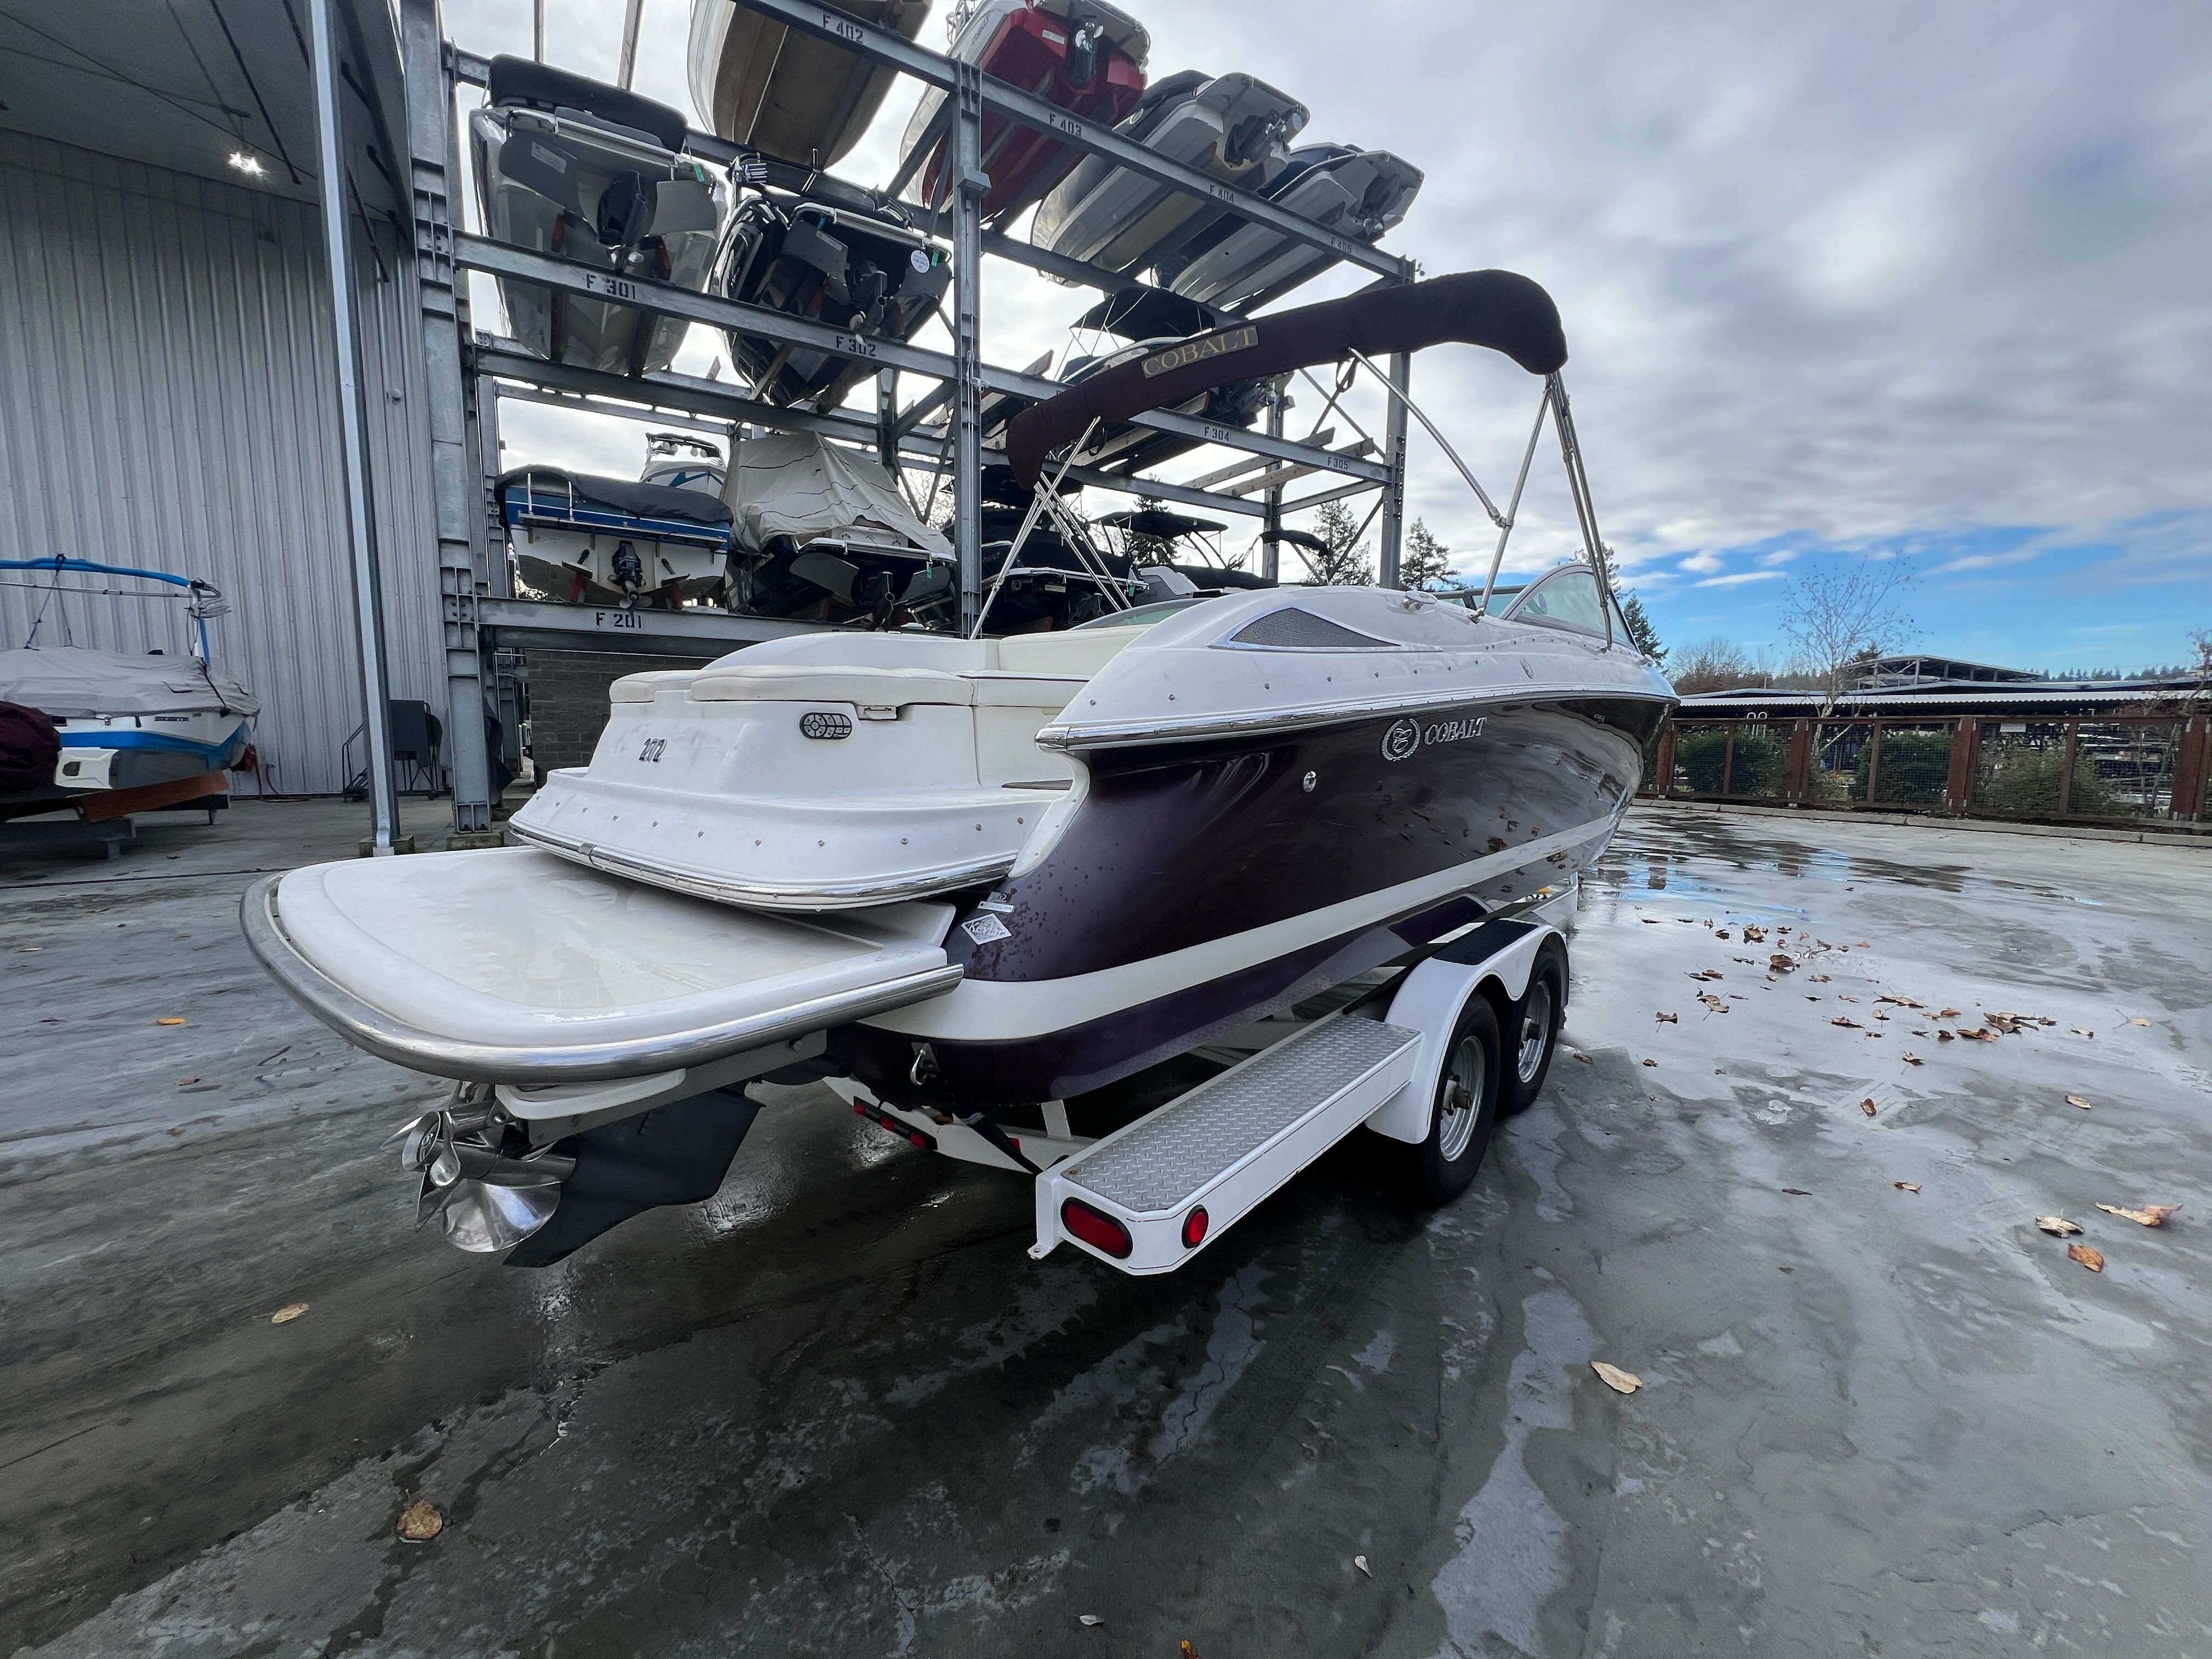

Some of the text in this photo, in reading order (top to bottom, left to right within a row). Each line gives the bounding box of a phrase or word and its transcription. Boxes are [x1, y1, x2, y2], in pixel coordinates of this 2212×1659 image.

[823, 13, 864, 44] F 402
[1049, 113, 1082, 137] F 403
[1210, 184, 1234, 203] F 404
[1331, 236, 1336, 246] F
[586, 274, 635, 300] F 301
[836, 335, 876, 357] F 302
[1143, 328, 1256, 375] COBALT
[1204, 426, 1229, 442] F 304
[1328, 456, 1348, 470] F 305
[596, 612, 641, 629] F 201
[1424, 717, 1487, 745] COBALT
[639, 738, 667, 763] 272
